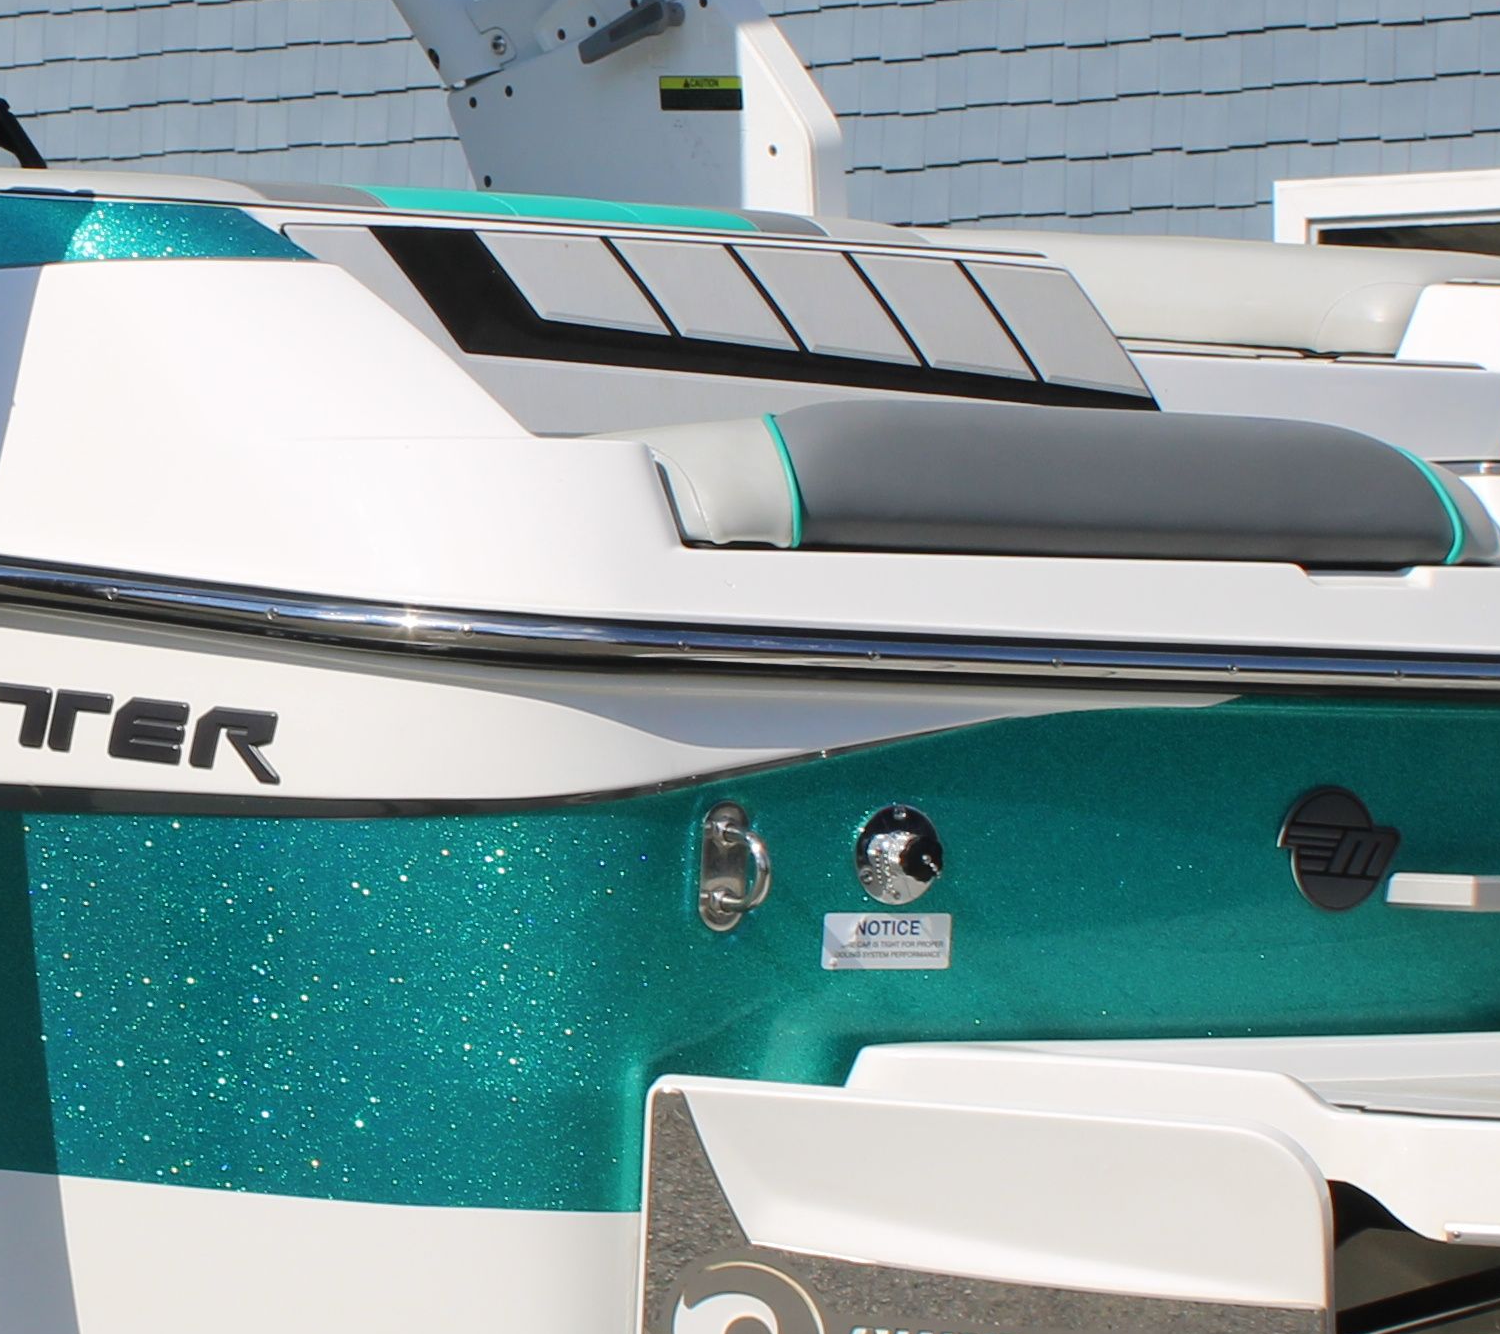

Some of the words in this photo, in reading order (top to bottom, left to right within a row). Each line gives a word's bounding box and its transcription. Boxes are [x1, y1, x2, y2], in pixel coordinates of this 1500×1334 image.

[856, 919, 923, 936] NOTICE
[901, 941, 916, 949] FOR
[917, 940, 944, 949] PROPER
[862, 951, 890, 959] SYSTEM
[891, 950, 941, 959] PERFORMANCE
